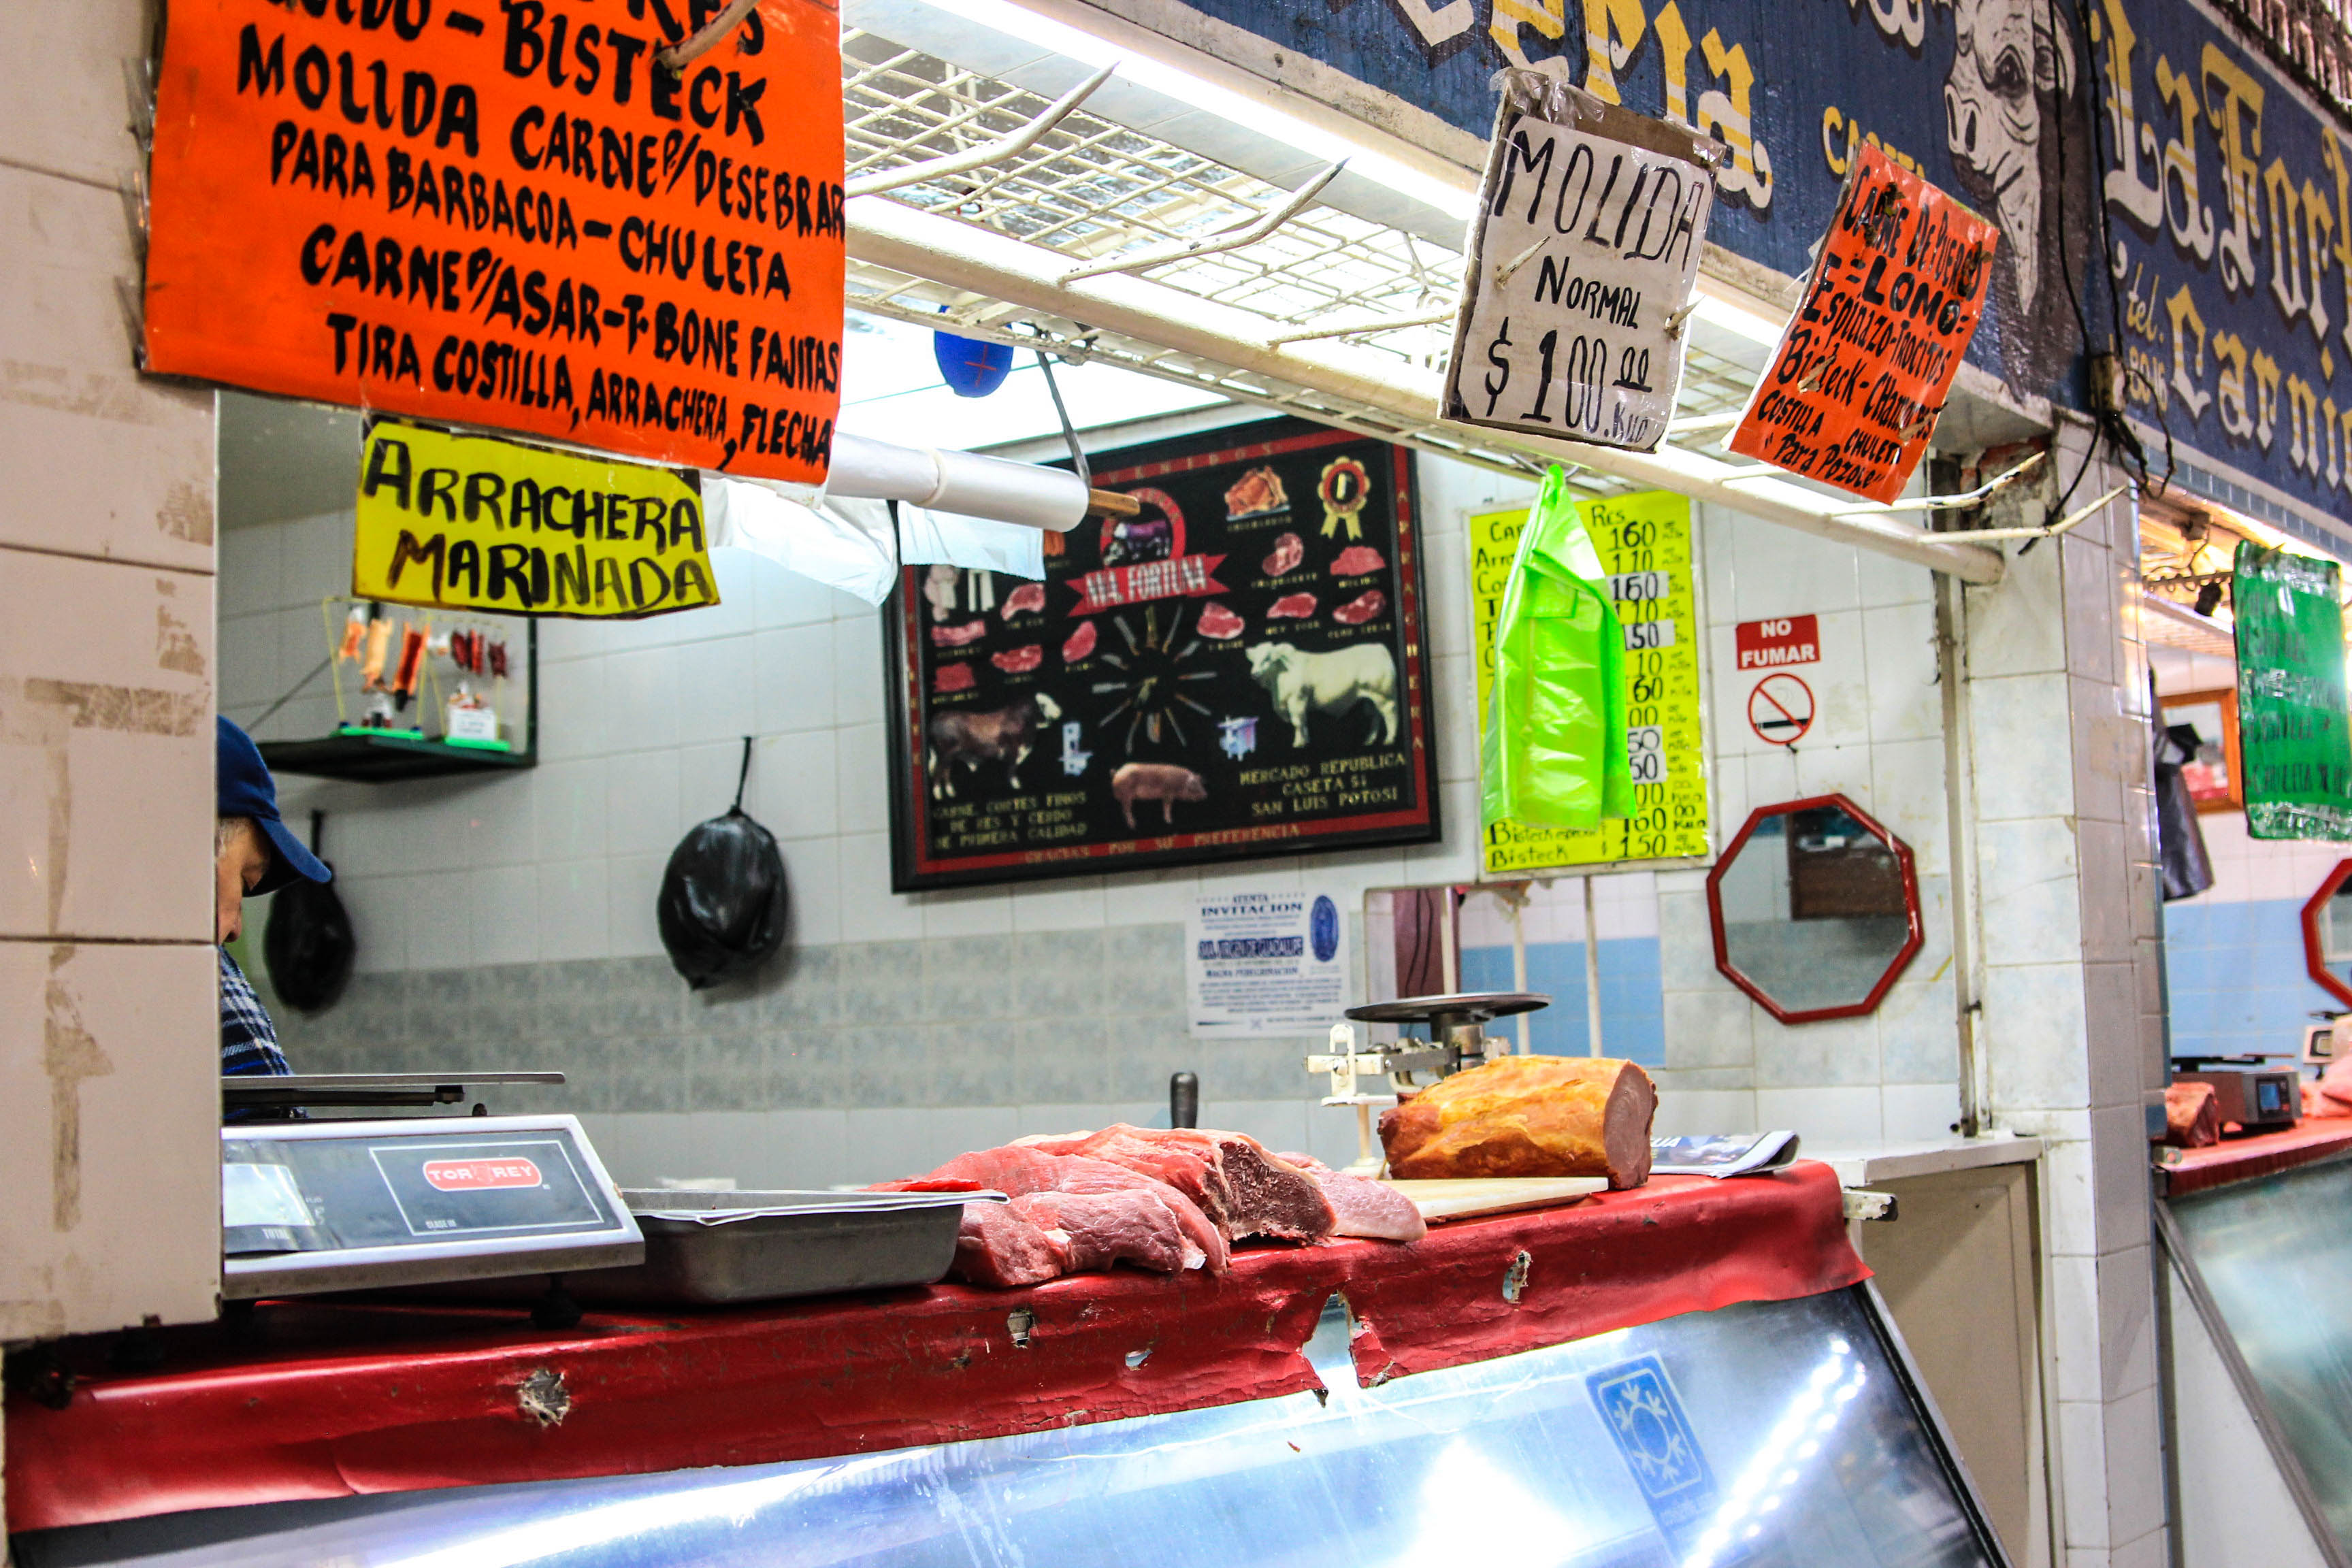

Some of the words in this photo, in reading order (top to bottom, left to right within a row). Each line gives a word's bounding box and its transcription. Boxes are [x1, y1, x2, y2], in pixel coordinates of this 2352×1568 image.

[237, 22, 479, 158] MOLIDA
[272, 120, 376, 199] PARA
[1494, 130, 1703, 272] MOLIDA
[1535, 255, 1639, 329] NORMAL
[327, 313, 421, 382] TIRA
[740, 404, 832, 470] FLECHA
[750, 326, 840, 394] FAJITAS
[1758, 389, 1825, 437] COSTILLA
[363, 438, 704, 557] ARRACHERA
[387, 529, 717, 610] MARINADA
[1741, 643, 1816, 668] FUMAR
[1760, 619, 1793, 639] NO
[1200, 900, 1303, 917] INVITACION
